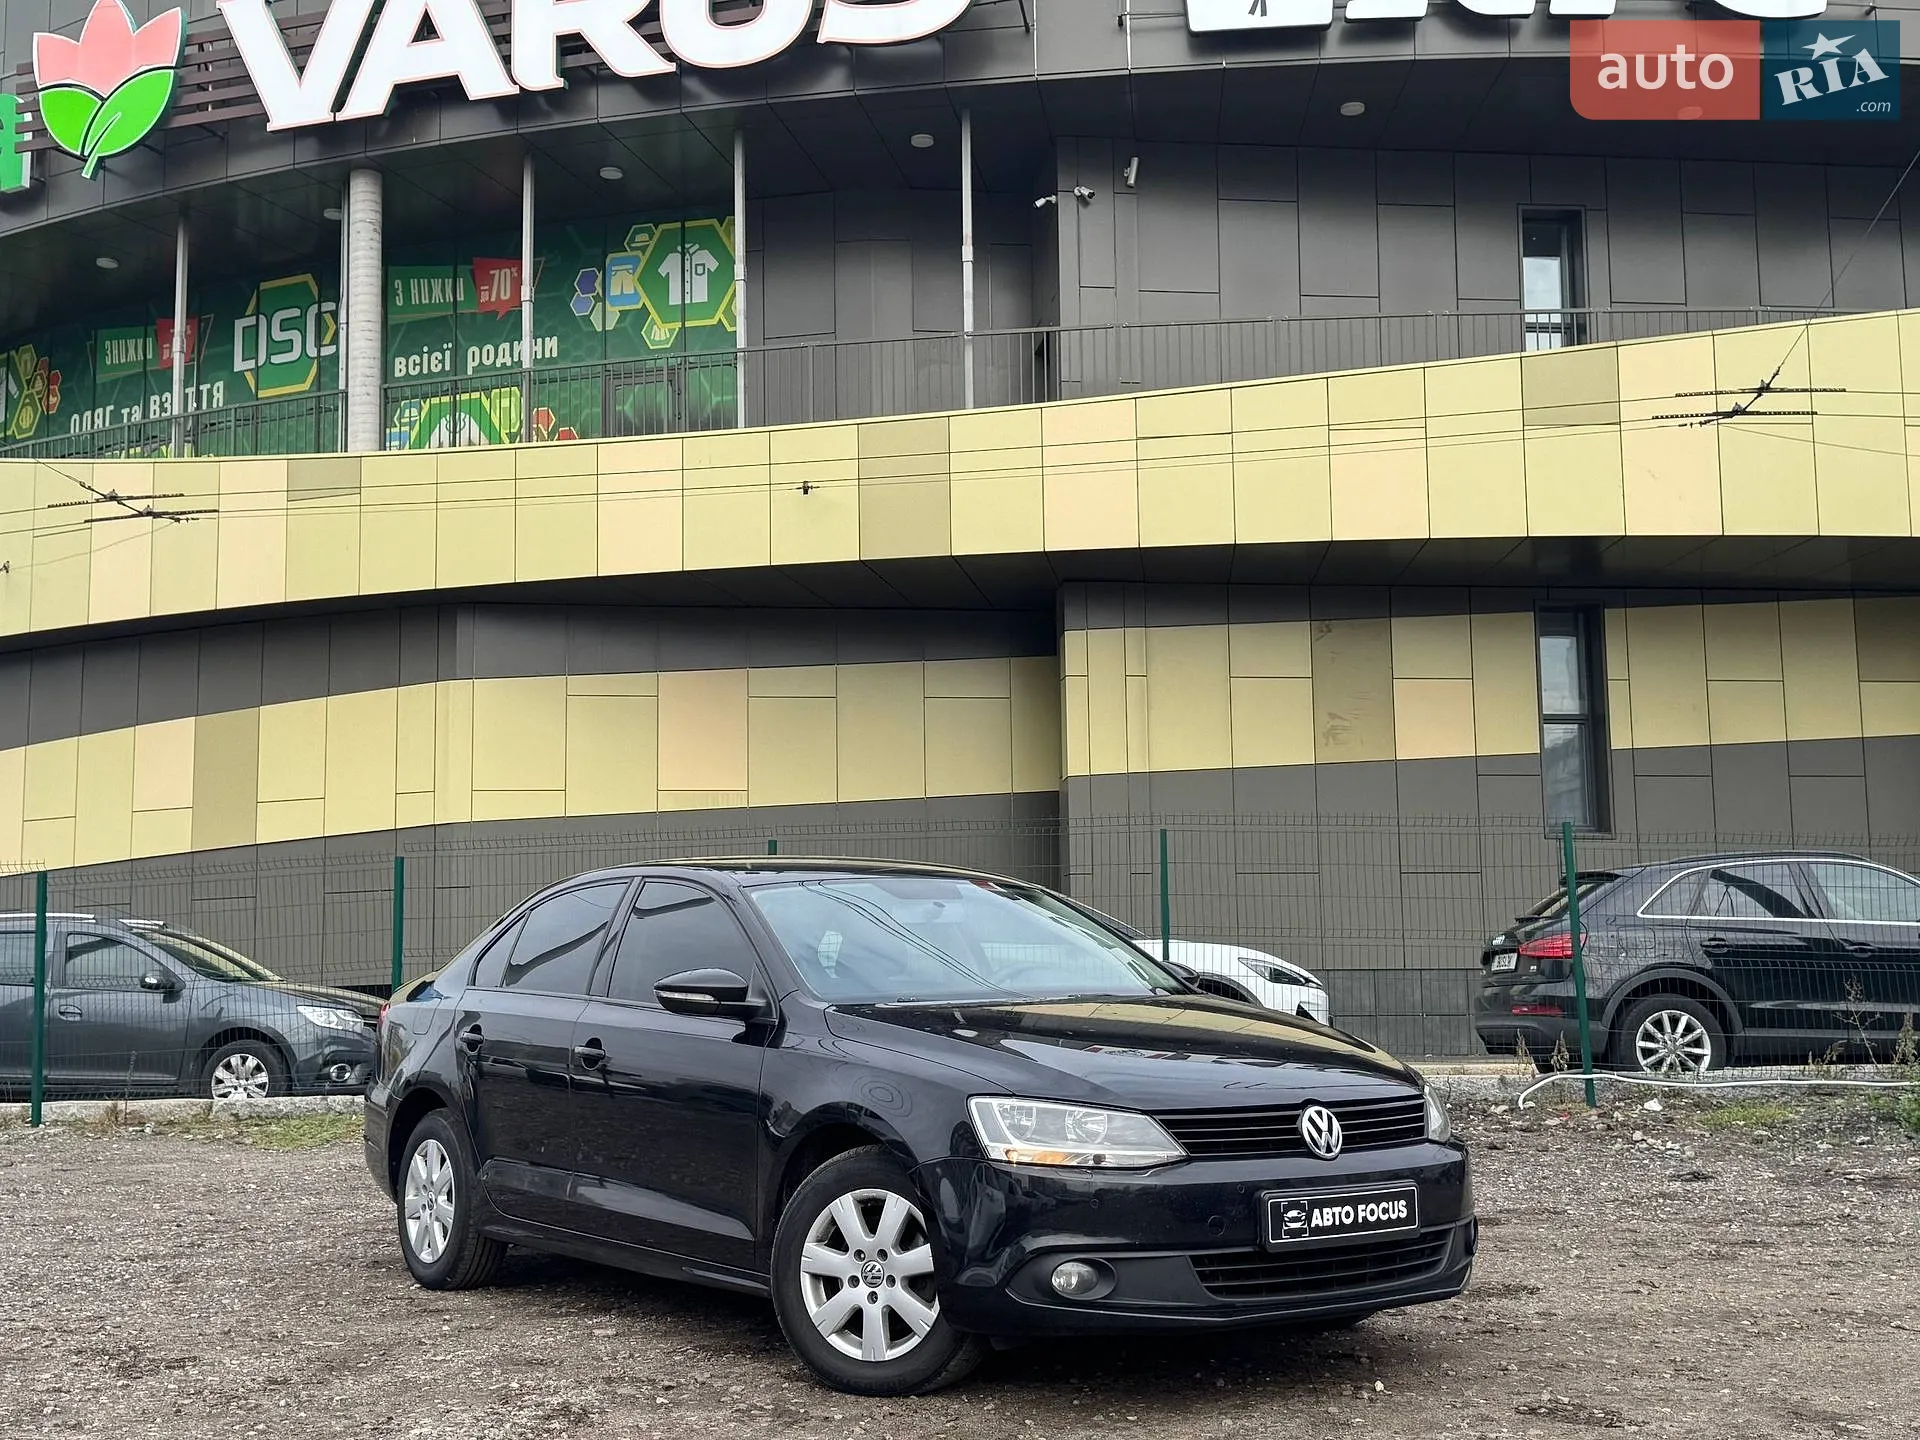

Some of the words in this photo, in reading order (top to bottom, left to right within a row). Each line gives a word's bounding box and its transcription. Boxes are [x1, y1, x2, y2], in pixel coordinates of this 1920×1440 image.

[233, 301, 337, 373] DSC
[394, 342, 453, 378] всієї
[466, 336, 558, 376] родини
[150, 381, 224, 420] ВЗТТЯ
[1357, 1199, 1408, 1223] FOCUS
